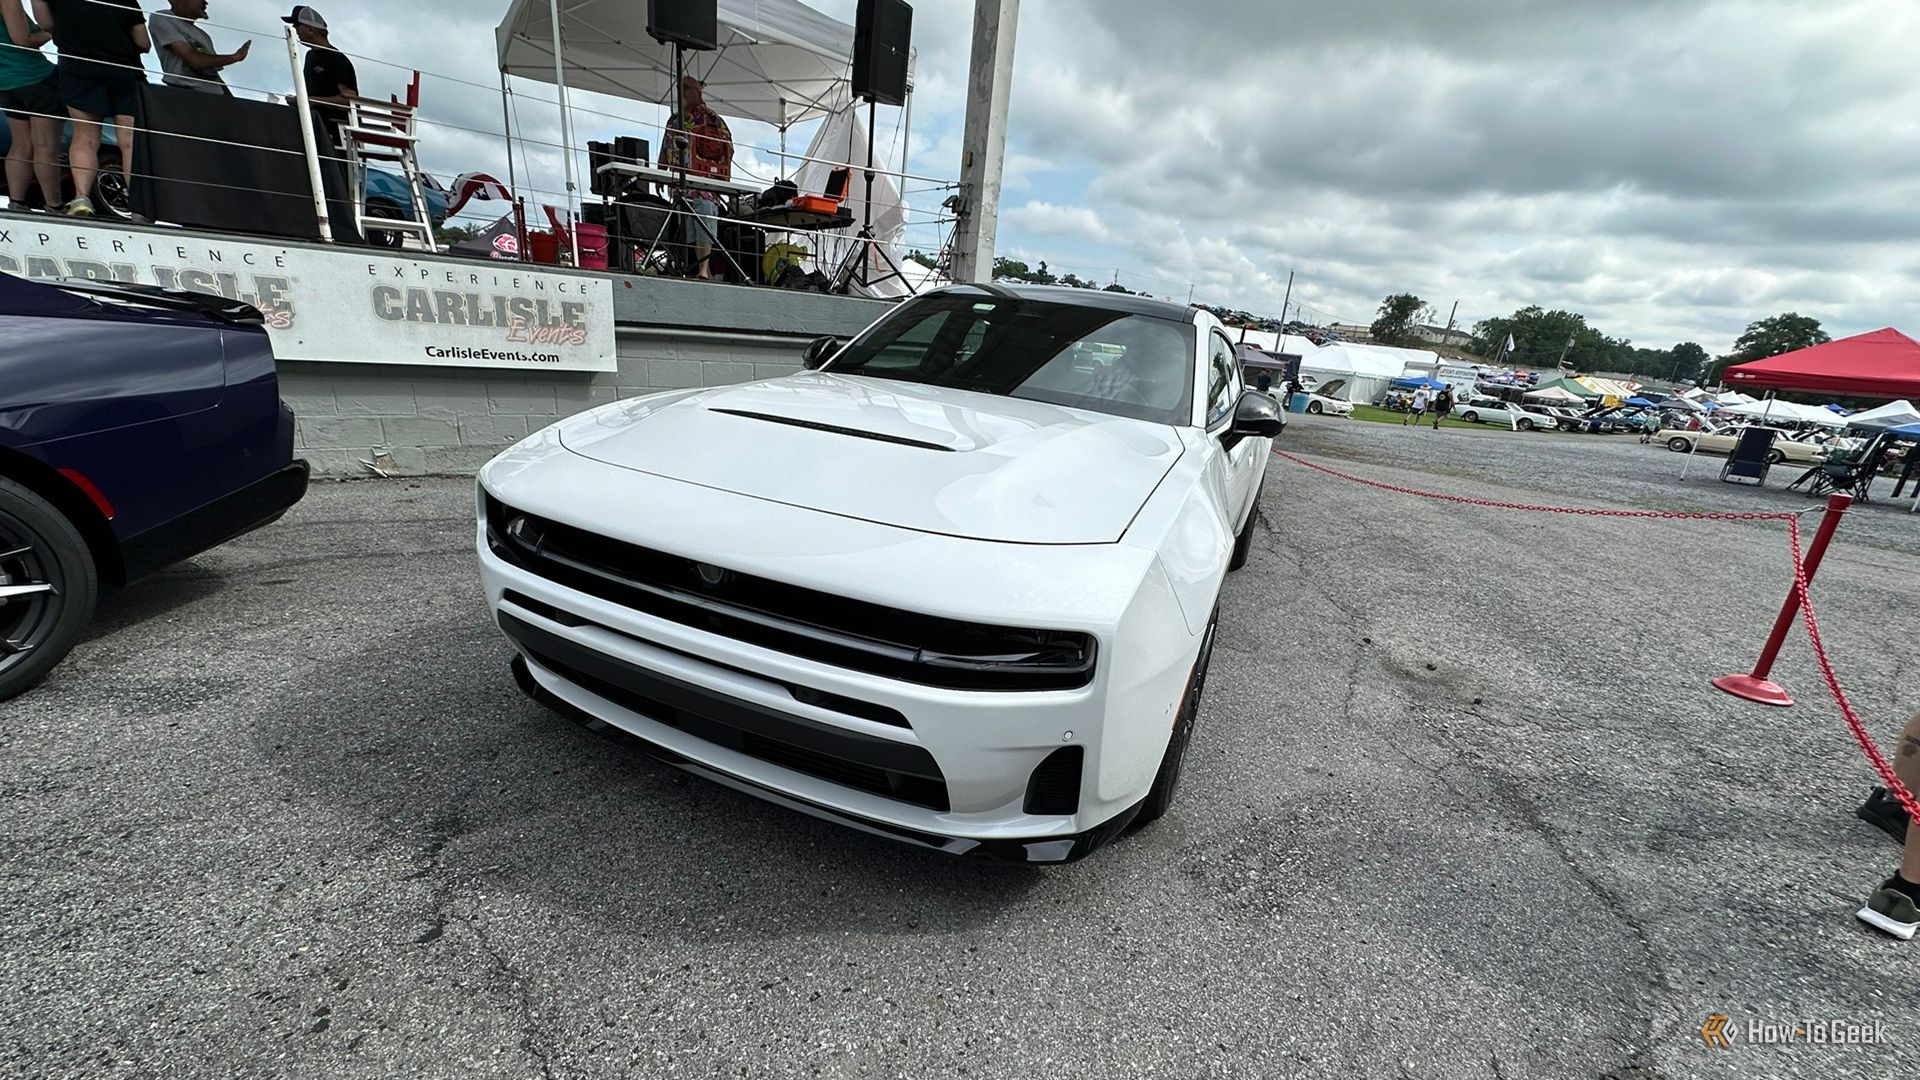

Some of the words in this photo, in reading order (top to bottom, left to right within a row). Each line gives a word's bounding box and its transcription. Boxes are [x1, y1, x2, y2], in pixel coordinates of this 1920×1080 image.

[0, 230, 285, 268] XPERIENCE
[368, 264, 588, 295] EXPERIENCE
[371, 284, 586, 330] CARLISLE
[508, 319, 586, 345] Events
[425, 346, 560, 362] CarlisleEvents.com
